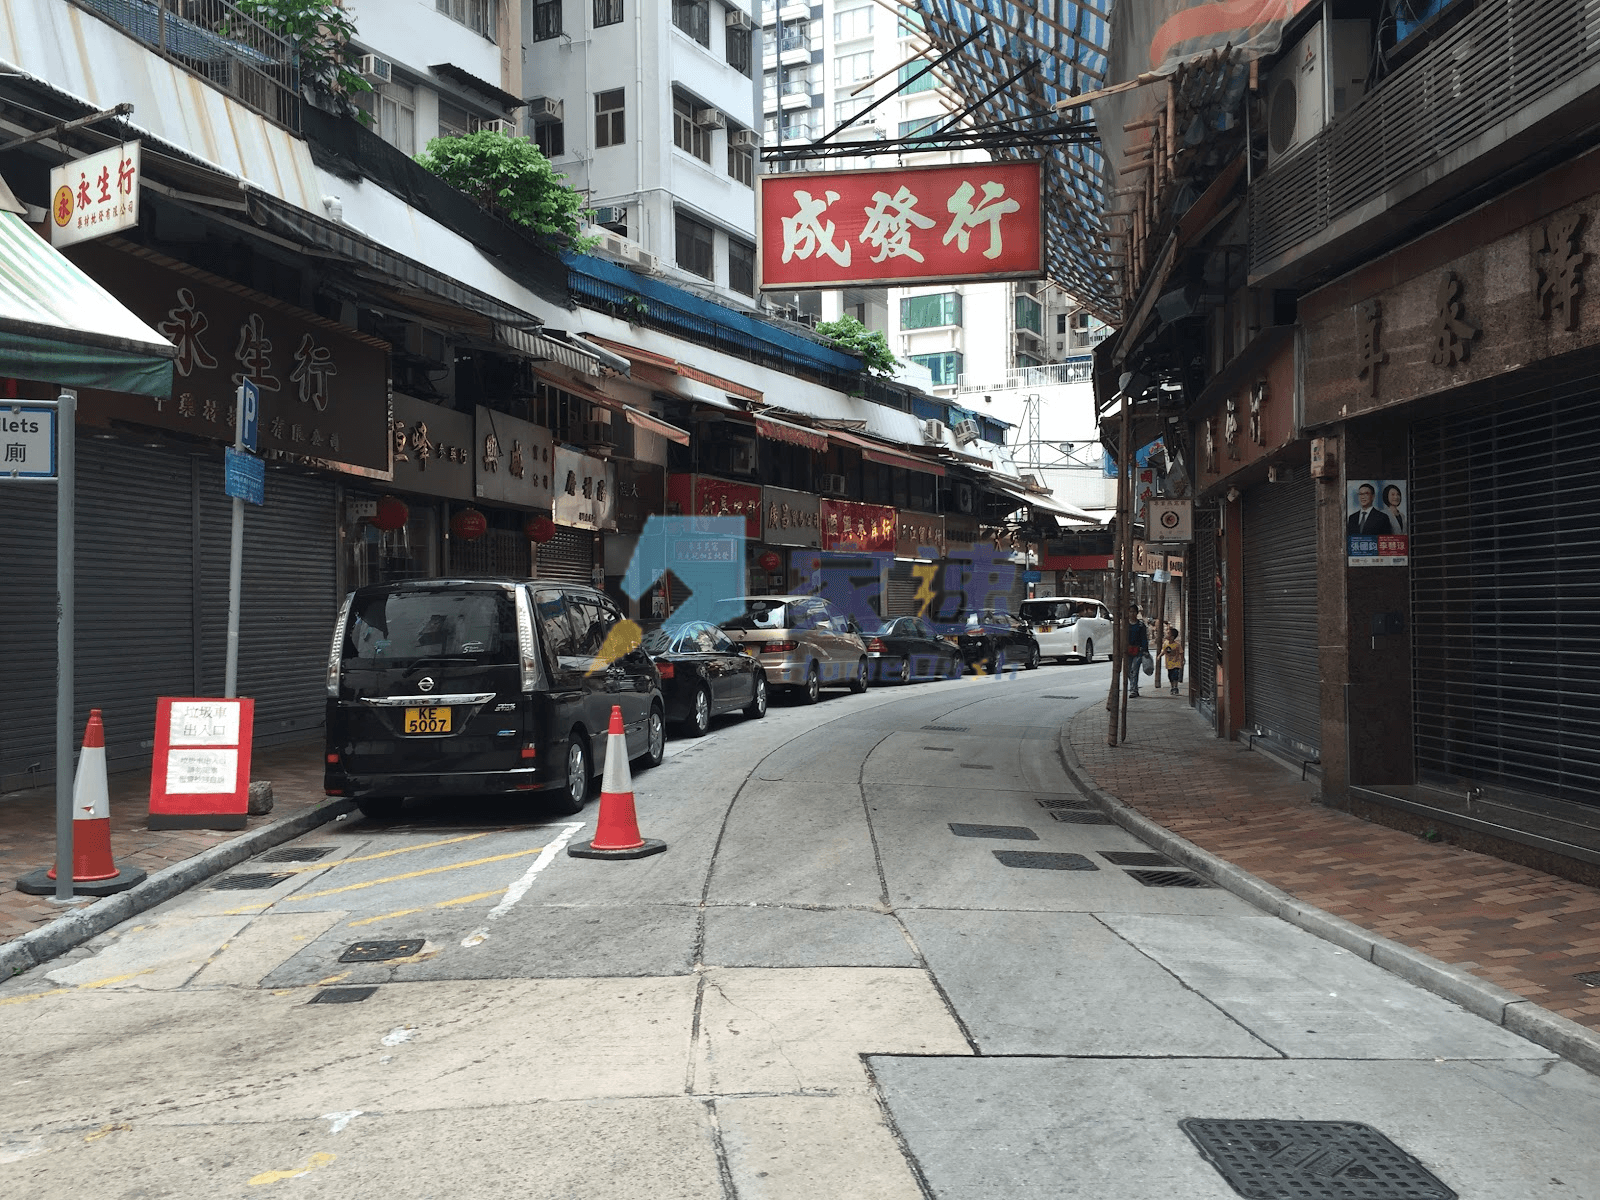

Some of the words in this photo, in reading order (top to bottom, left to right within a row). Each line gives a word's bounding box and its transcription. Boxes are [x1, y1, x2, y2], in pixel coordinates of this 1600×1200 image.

[77, 158, 136, 211] 永生行
[59, 192, 71, 220] 永
[781, 180, 1020, 267] 成發行
[157, 287, 337, 412] 永生行
[244, 386, 256, 440] P
[184, 723, 225, 737] 出入口
[409, 719, 447, 732] 5007
[418, 707, 437, 720] KE
